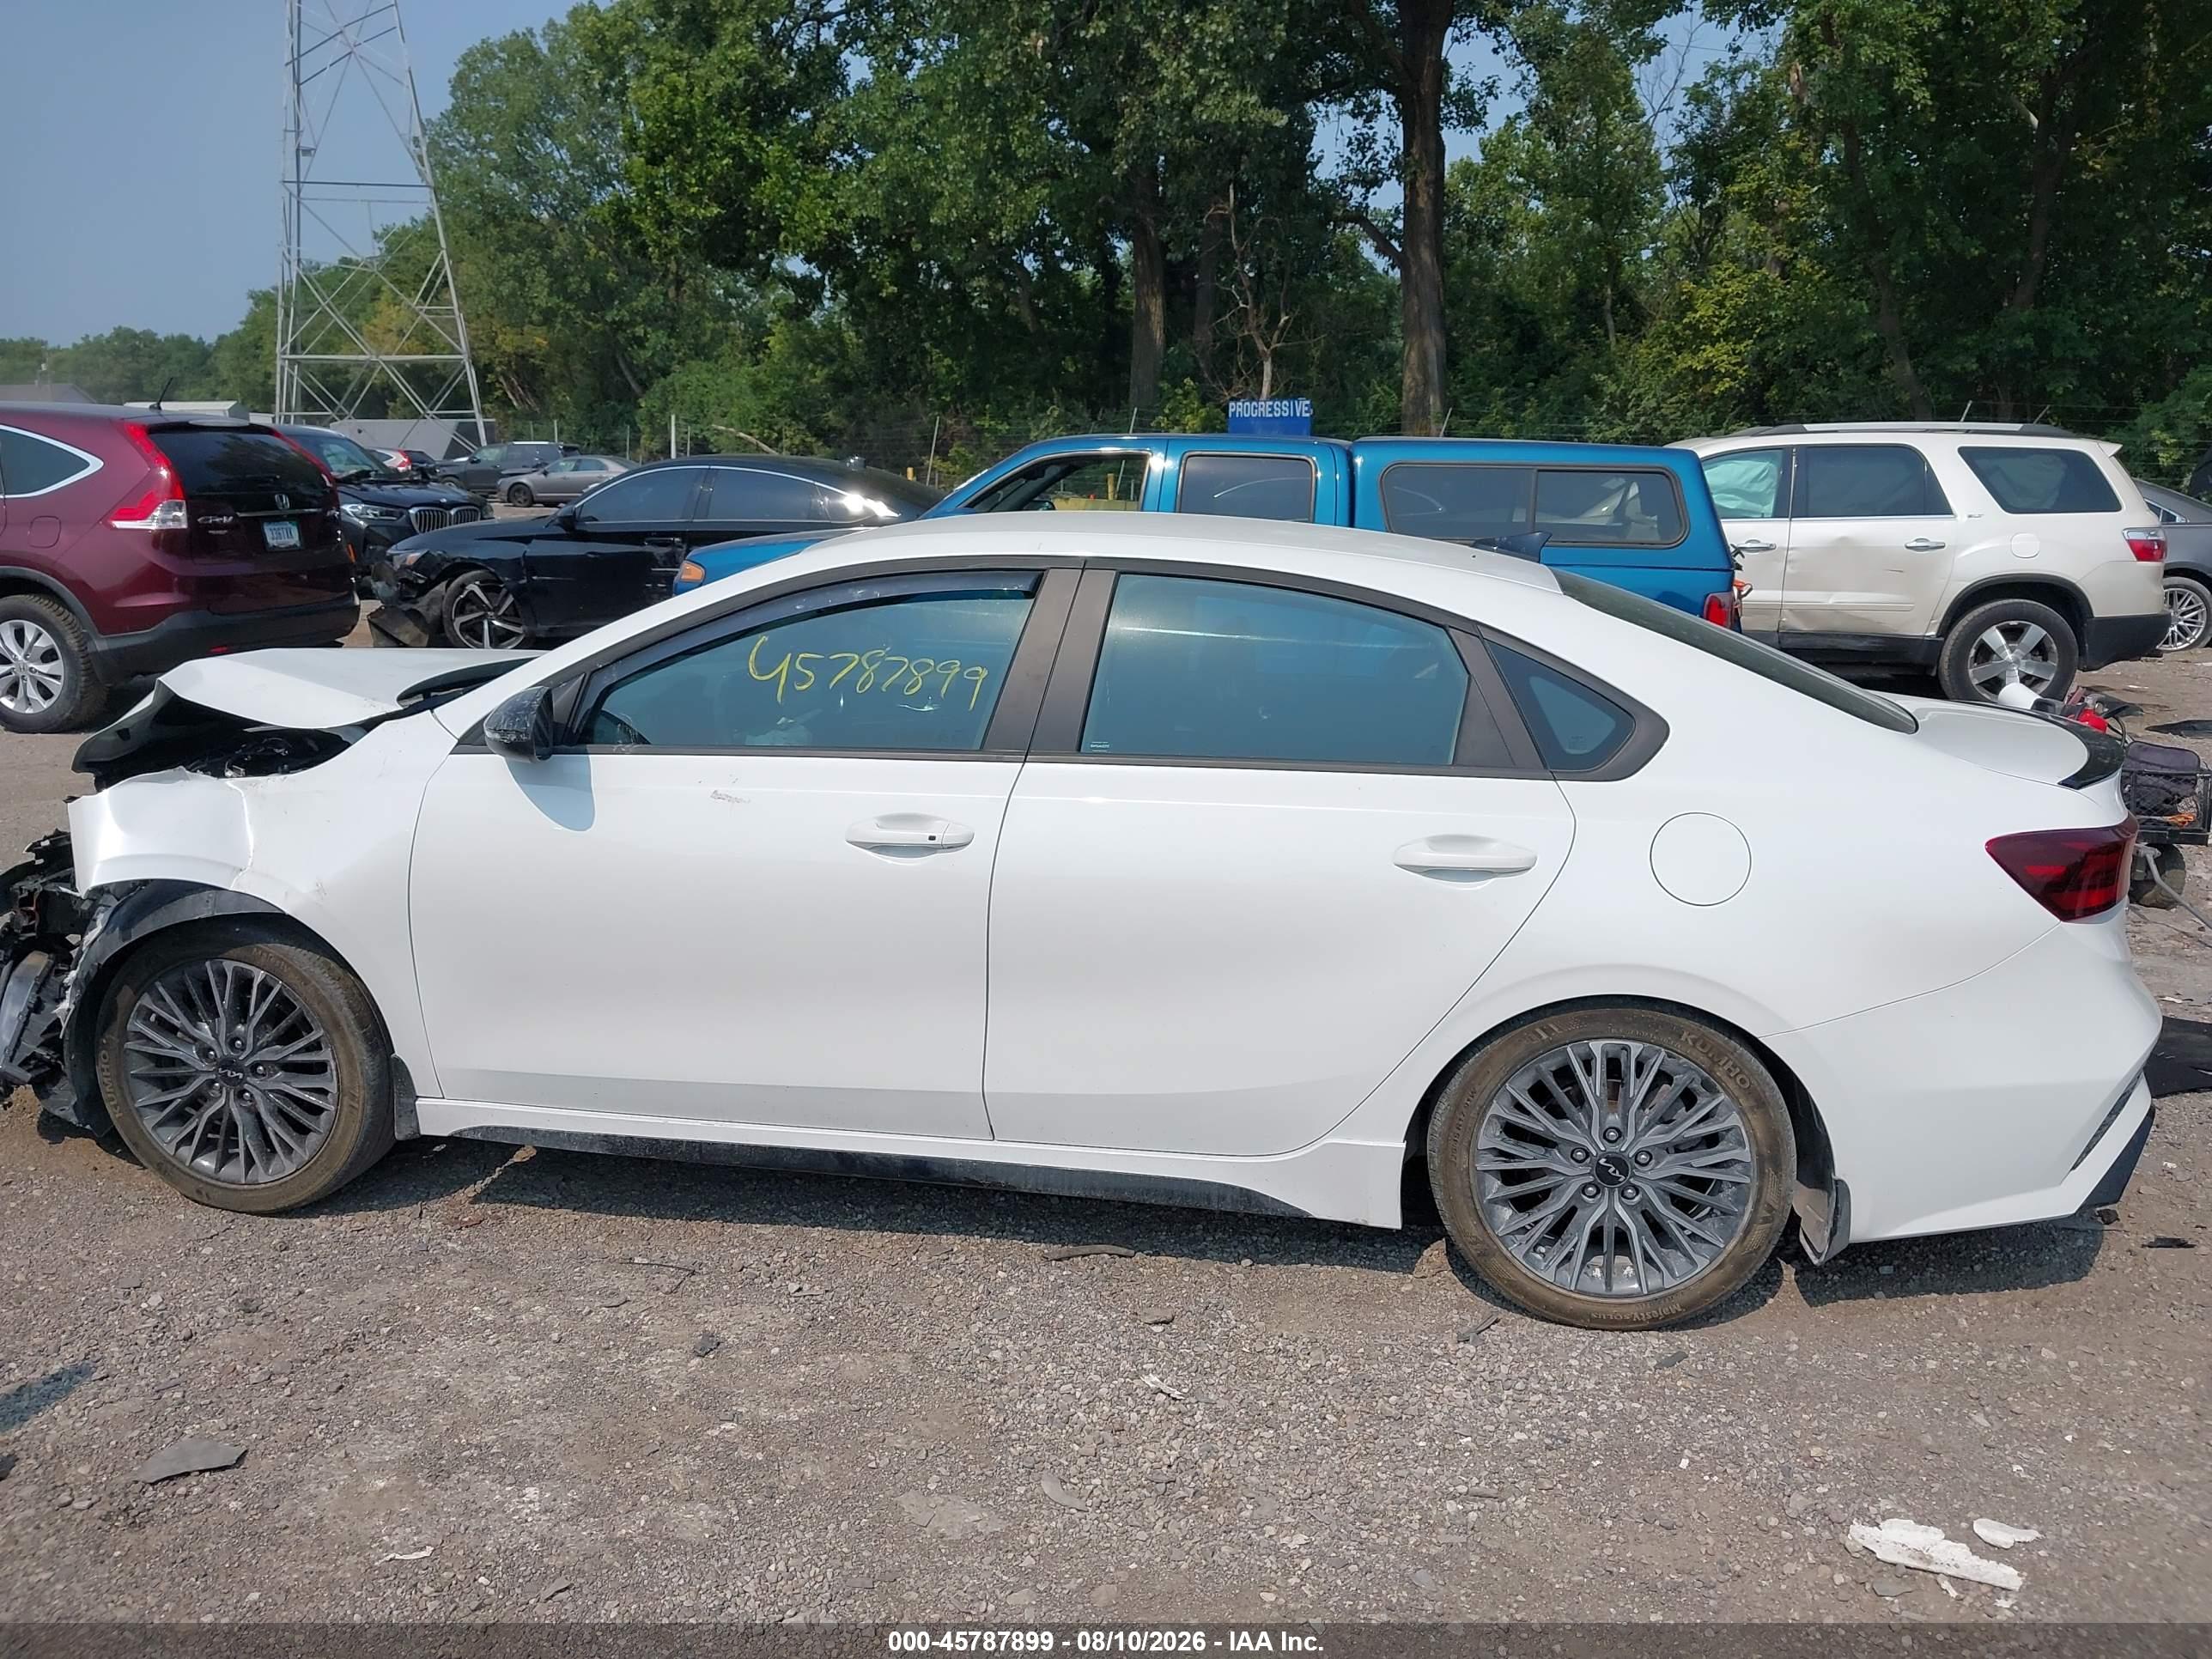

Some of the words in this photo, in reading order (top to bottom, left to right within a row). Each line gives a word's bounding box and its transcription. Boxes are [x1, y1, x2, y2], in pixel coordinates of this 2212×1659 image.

[1228, 400, 1310, 417] PROGRESSIVE
[748, 635, 988, 711] 45787899
[100, 1049, 124, 1119] KUMHO
[1680, 1030, 1750, 1089] KUMHO
